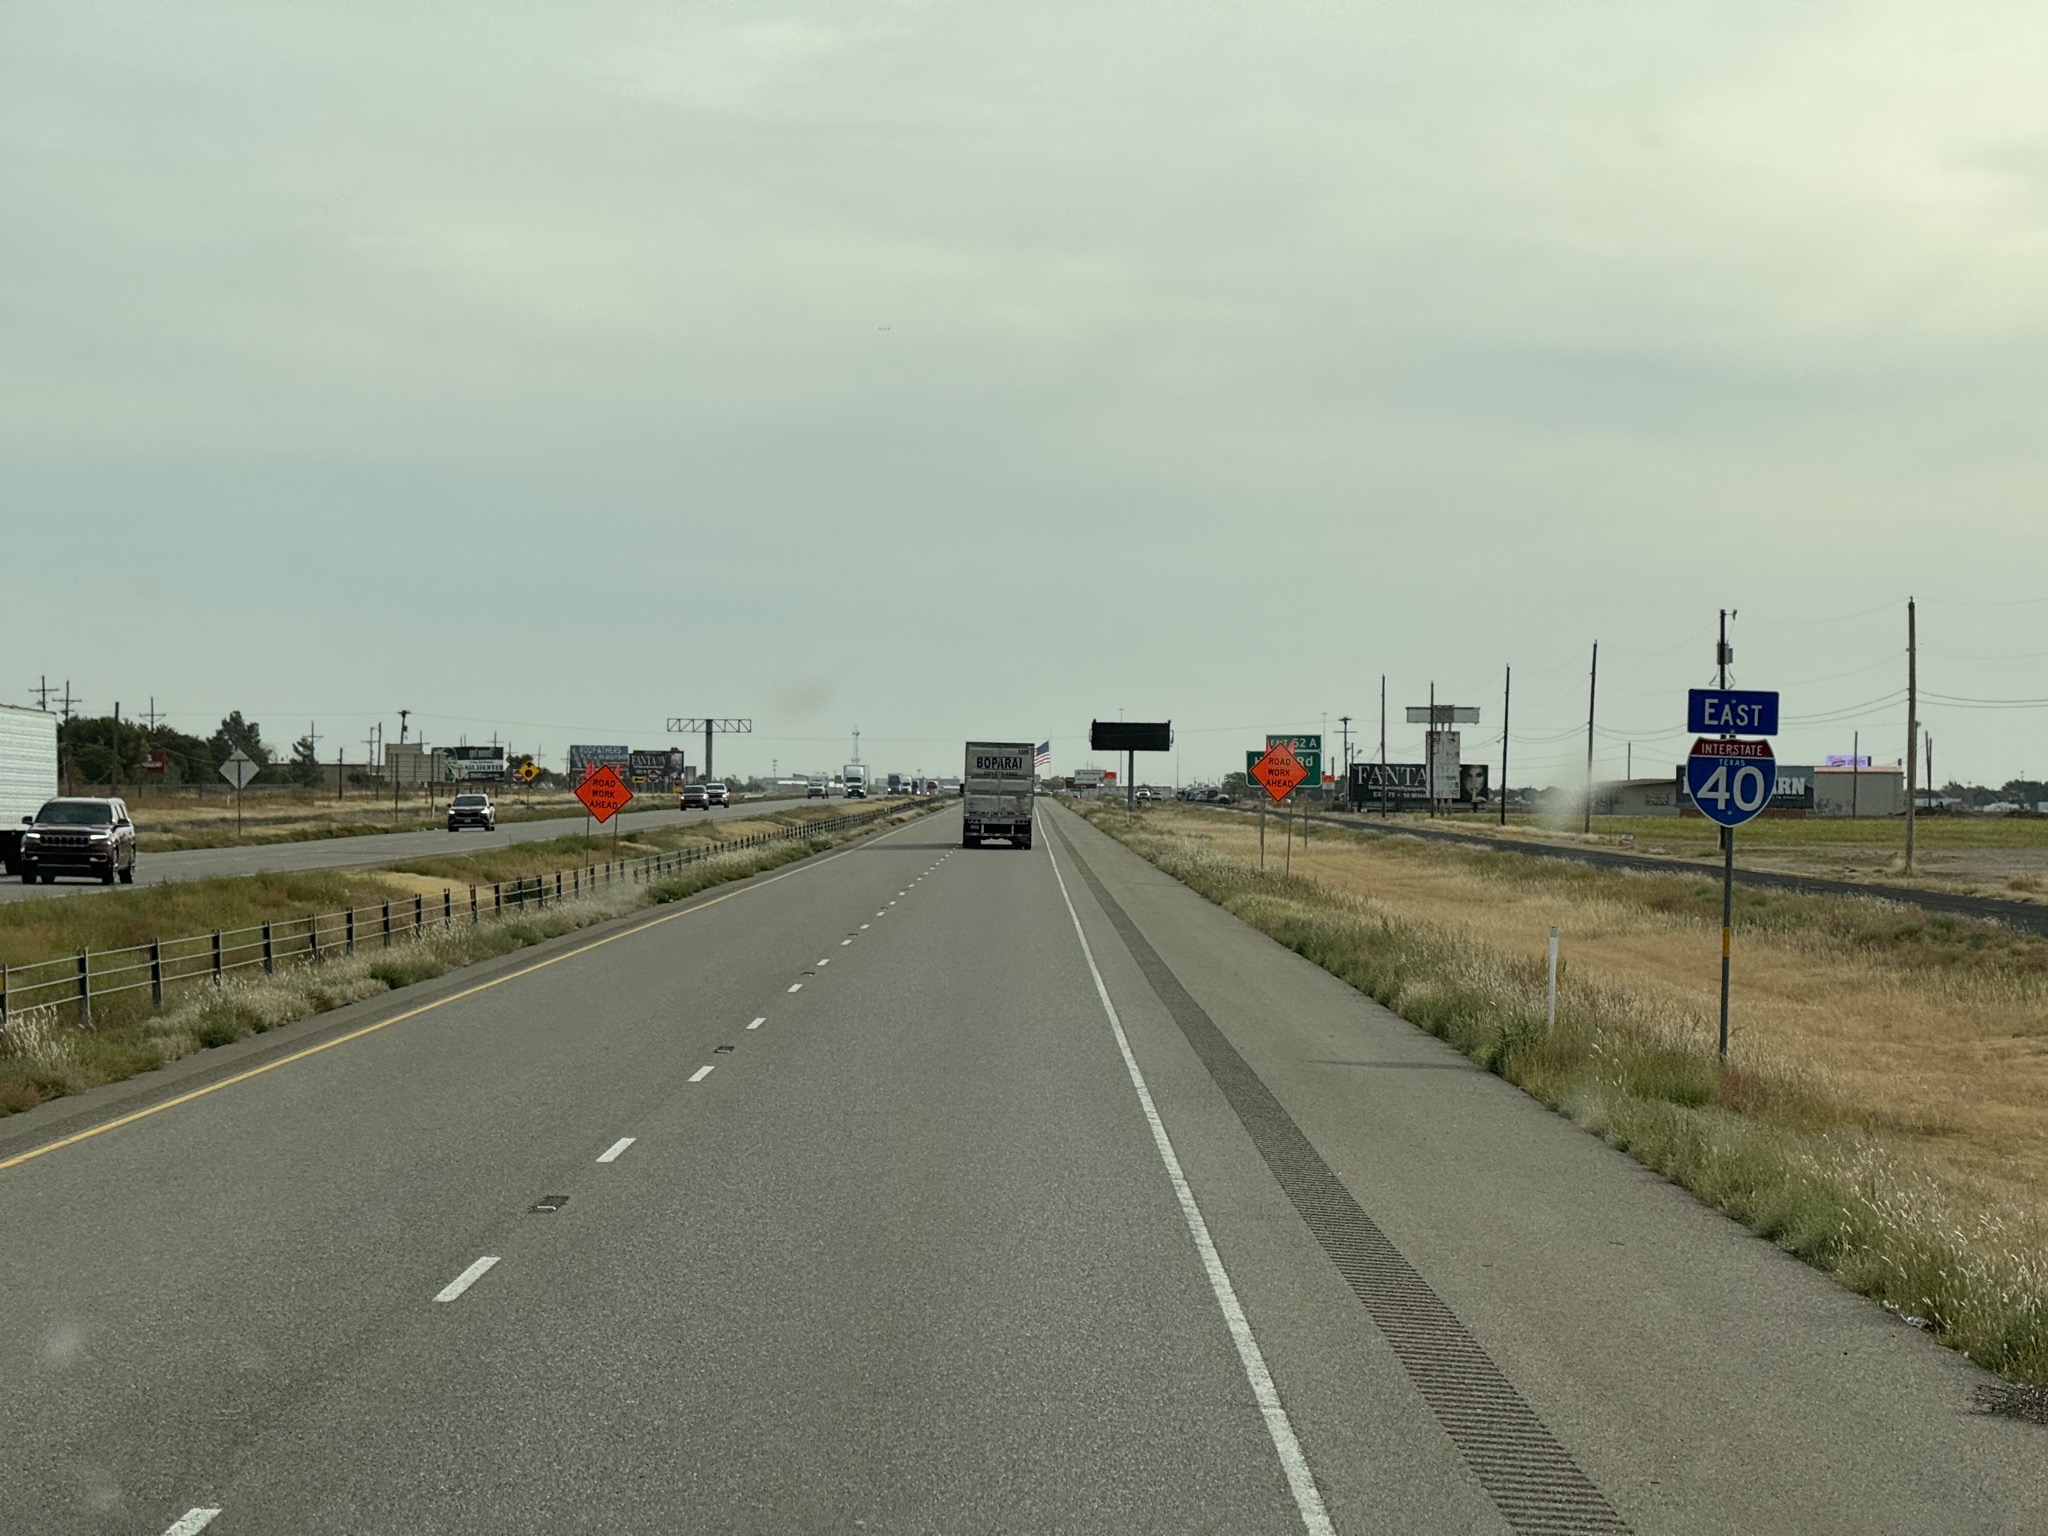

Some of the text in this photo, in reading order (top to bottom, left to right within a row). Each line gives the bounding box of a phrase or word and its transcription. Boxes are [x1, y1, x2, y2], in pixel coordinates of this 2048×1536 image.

[1704, 698, 1762, 727] EAST
[1270, 739, 1288, 747] EXT
[1309, 738, 1317, 748] A
[1701, 743, 1763, 756] INTERSTATE
[976, 757, 1023, 769] BOPARAI
[1268, 758, 1291, 766] ROAD
[1297, 755, 1313, 767] Rd
[1719, 758, 1746, 767] TEXAS
[1268, 768, 1291, 777] WORK
[593, 778, 616, 787] ROAD
[1265, 779, 1293, 788] AHEAD
[1697, 766, 1765, 812] 40
[592, 790, 615, 799] WORK
[589, 800, 618, 810] AHEAD
